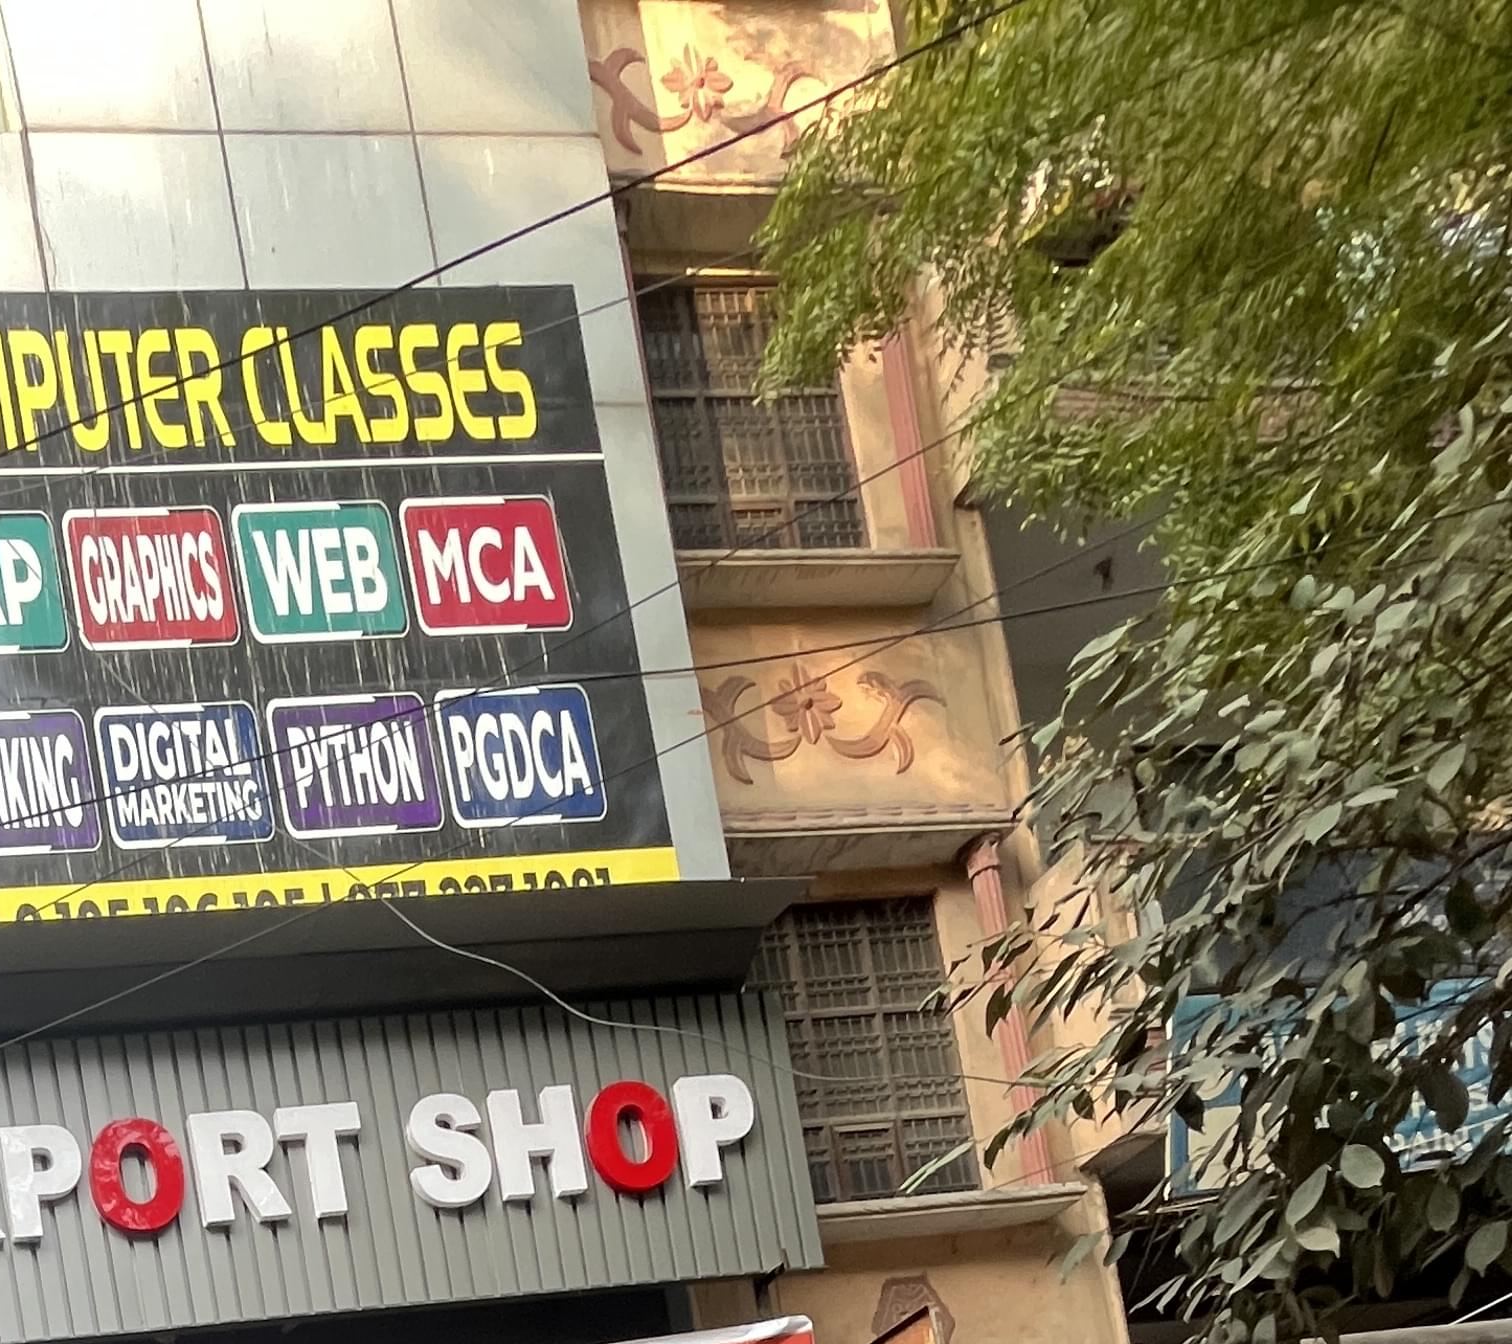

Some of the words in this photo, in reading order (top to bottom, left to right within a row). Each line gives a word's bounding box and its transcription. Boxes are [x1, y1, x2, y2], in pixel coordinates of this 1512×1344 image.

[239, 319, 539, 446] CLASSES
[79, 528, 225, 629] GRAPHICS
[260, 526, 388, 617] WEB
[419, 524, 555, 609] MCA
[109, 719, 249, 783] DIGITAL
[285, 724, 425, 813] PYTHON
[452, 706, 594, 801] PGDCA
[115, 773, 263, 828] MARKETING
[406, 1072, 755, 1210] SHOP
